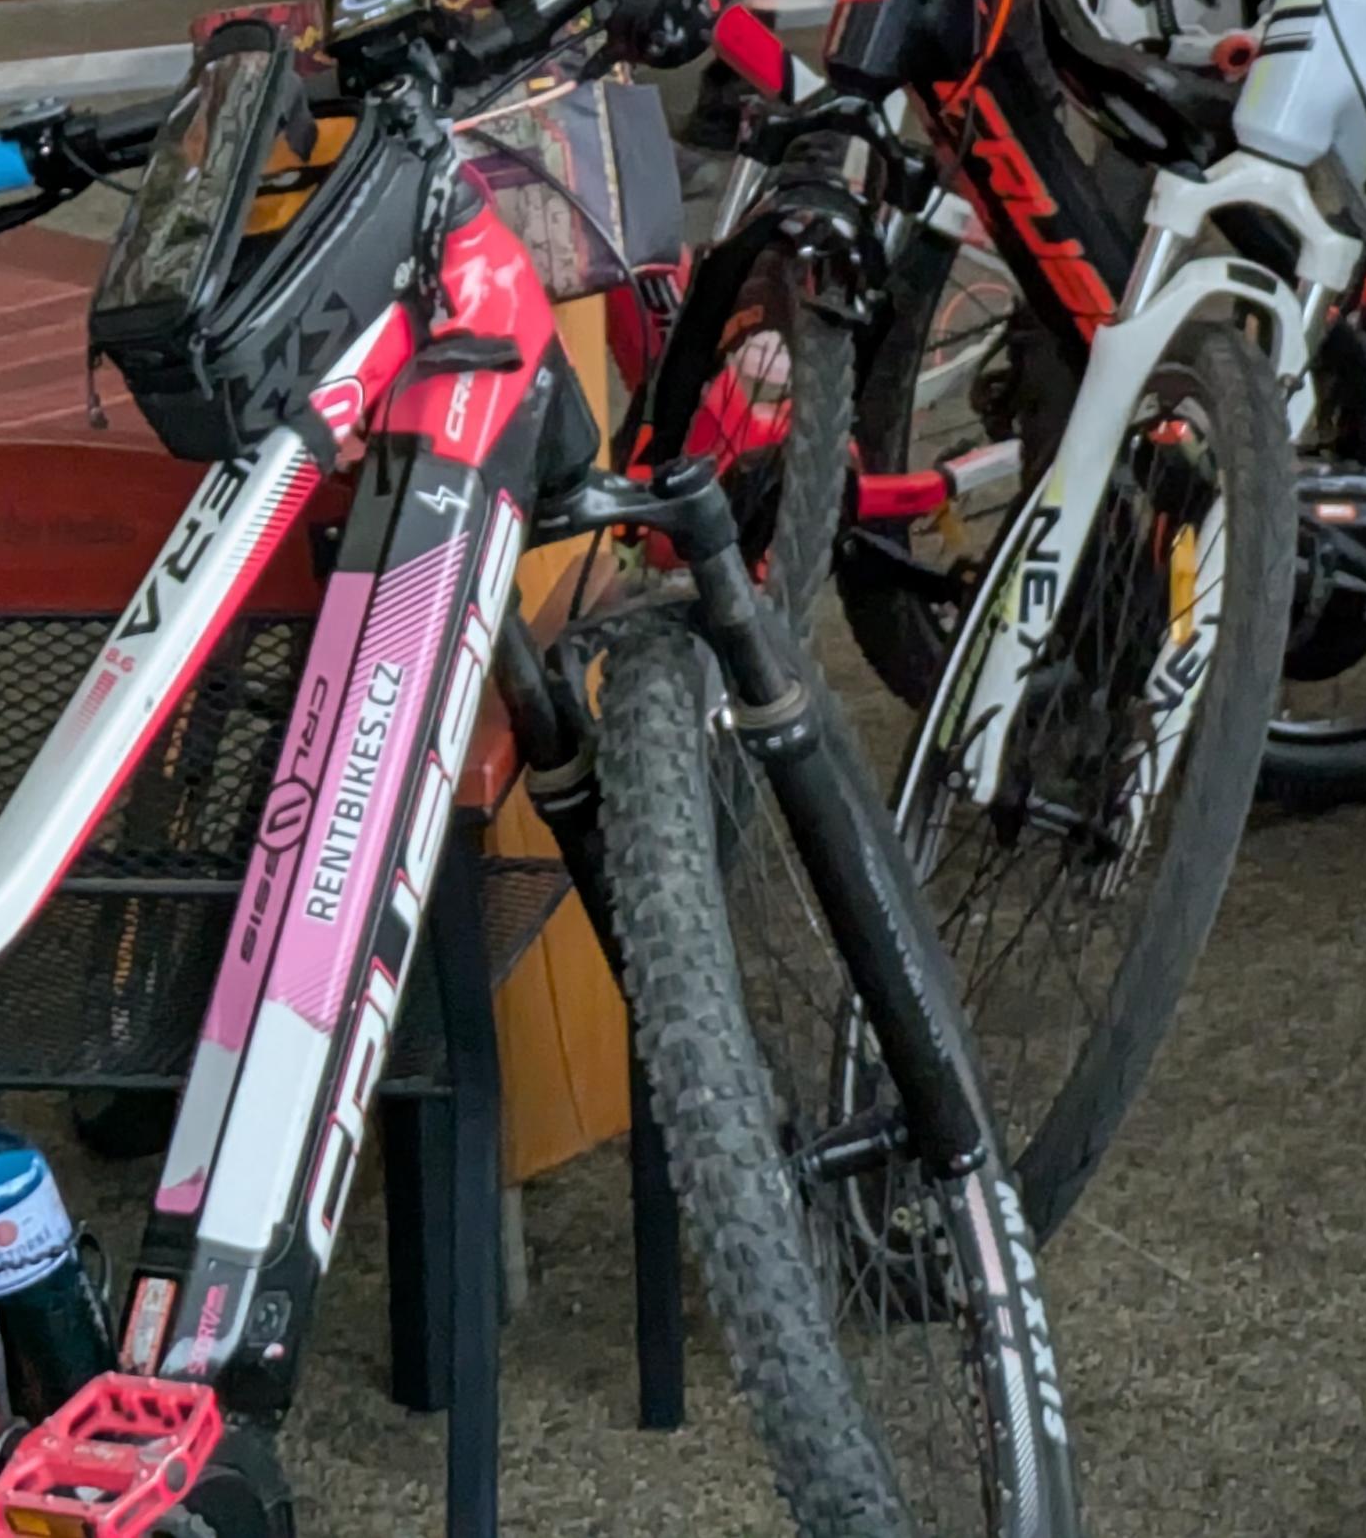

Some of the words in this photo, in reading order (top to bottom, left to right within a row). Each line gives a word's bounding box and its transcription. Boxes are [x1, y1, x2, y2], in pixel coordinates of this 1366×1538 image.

[115, 447, 261, 641] ERA
[305, 660, 405, 922] RENTBIKES.CZ
[993, 1178, 1070, 1446] MAXXIS
